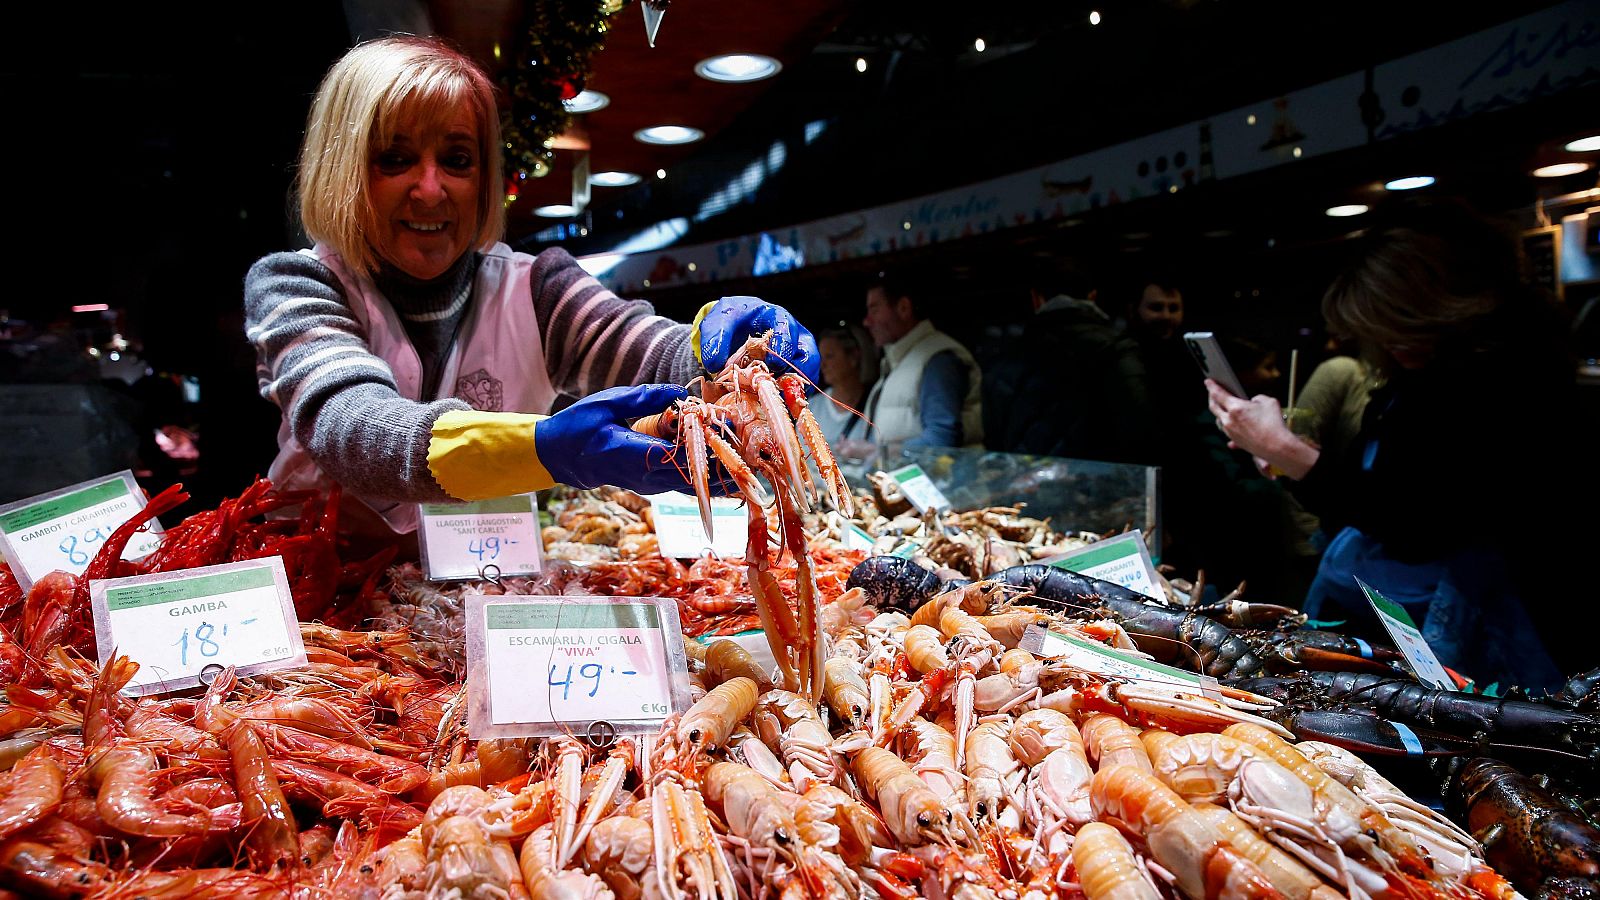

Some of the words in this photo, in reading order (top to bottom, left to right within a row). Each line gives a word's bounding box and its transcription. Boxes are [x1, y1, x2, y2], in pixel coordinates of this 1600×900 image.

[21, 523, 62, 542] GAMBOT
[70, 502, 127, 526] CARABINERO
[477, 518, 523, 526] LANGOSTINO
[169, 600, 228, 617] GAMBA
[509, 635, 586, 646] ESCAMARLA
[597, 635, 642, 645] CIGALA
[641, 704, 648, 712] €
[651, 703, 668, 714] Kg
